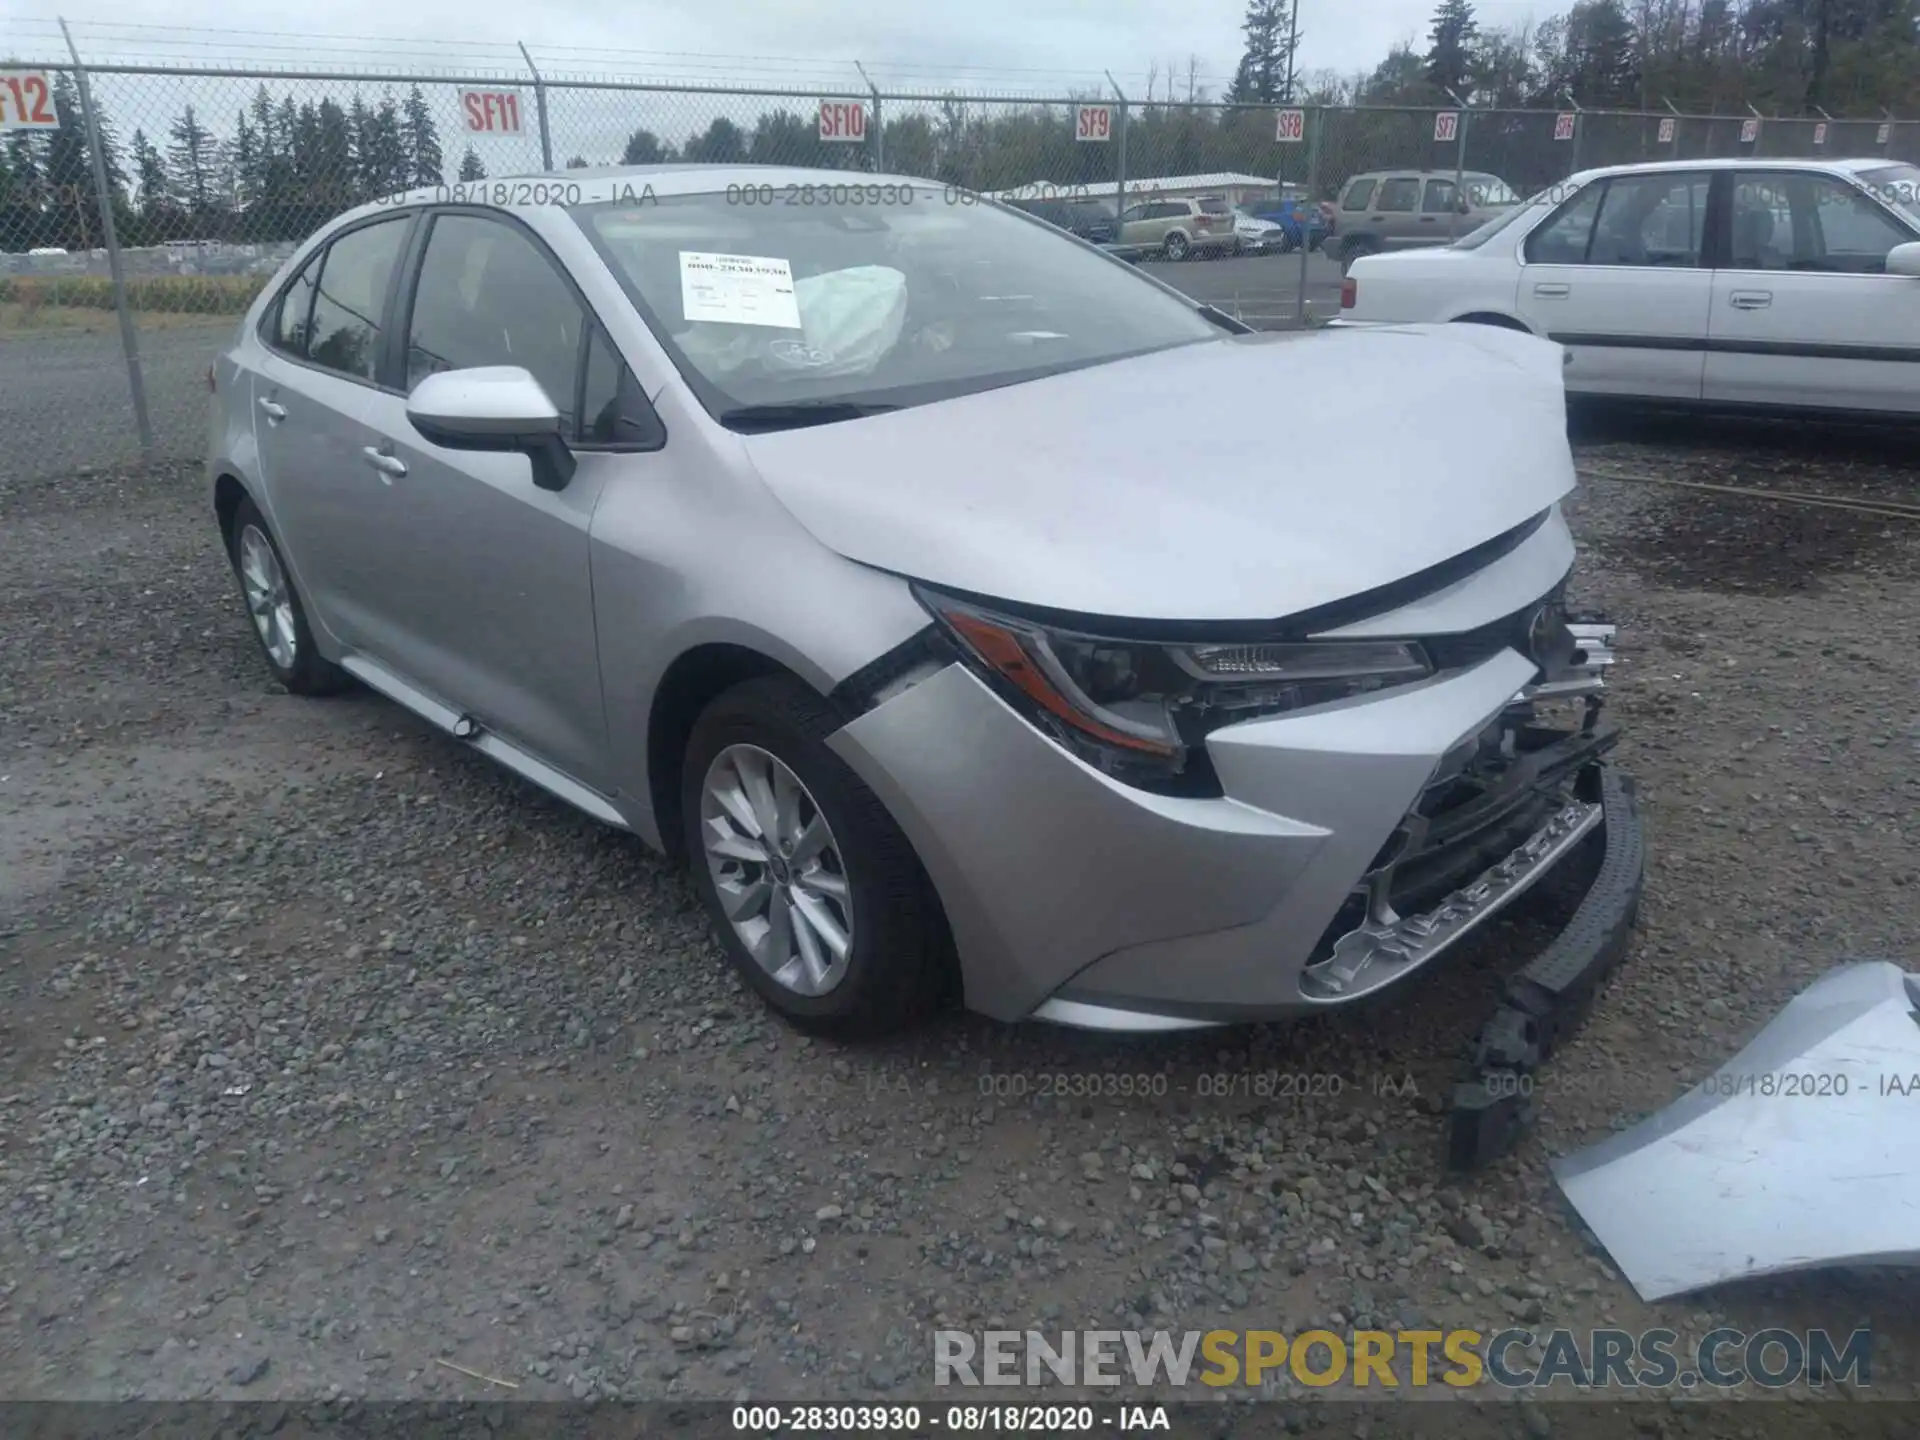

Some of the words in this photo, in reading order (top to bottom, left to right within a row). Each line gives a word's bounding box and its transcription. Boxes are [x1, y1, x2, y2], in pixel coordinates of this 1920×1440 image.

[464, 92, 520, 132] SF11
[821, 103, 863, 137] SF10
[1079, 107, 1109, 136] SF9
[1280, 112, 1301, 138] SF8
